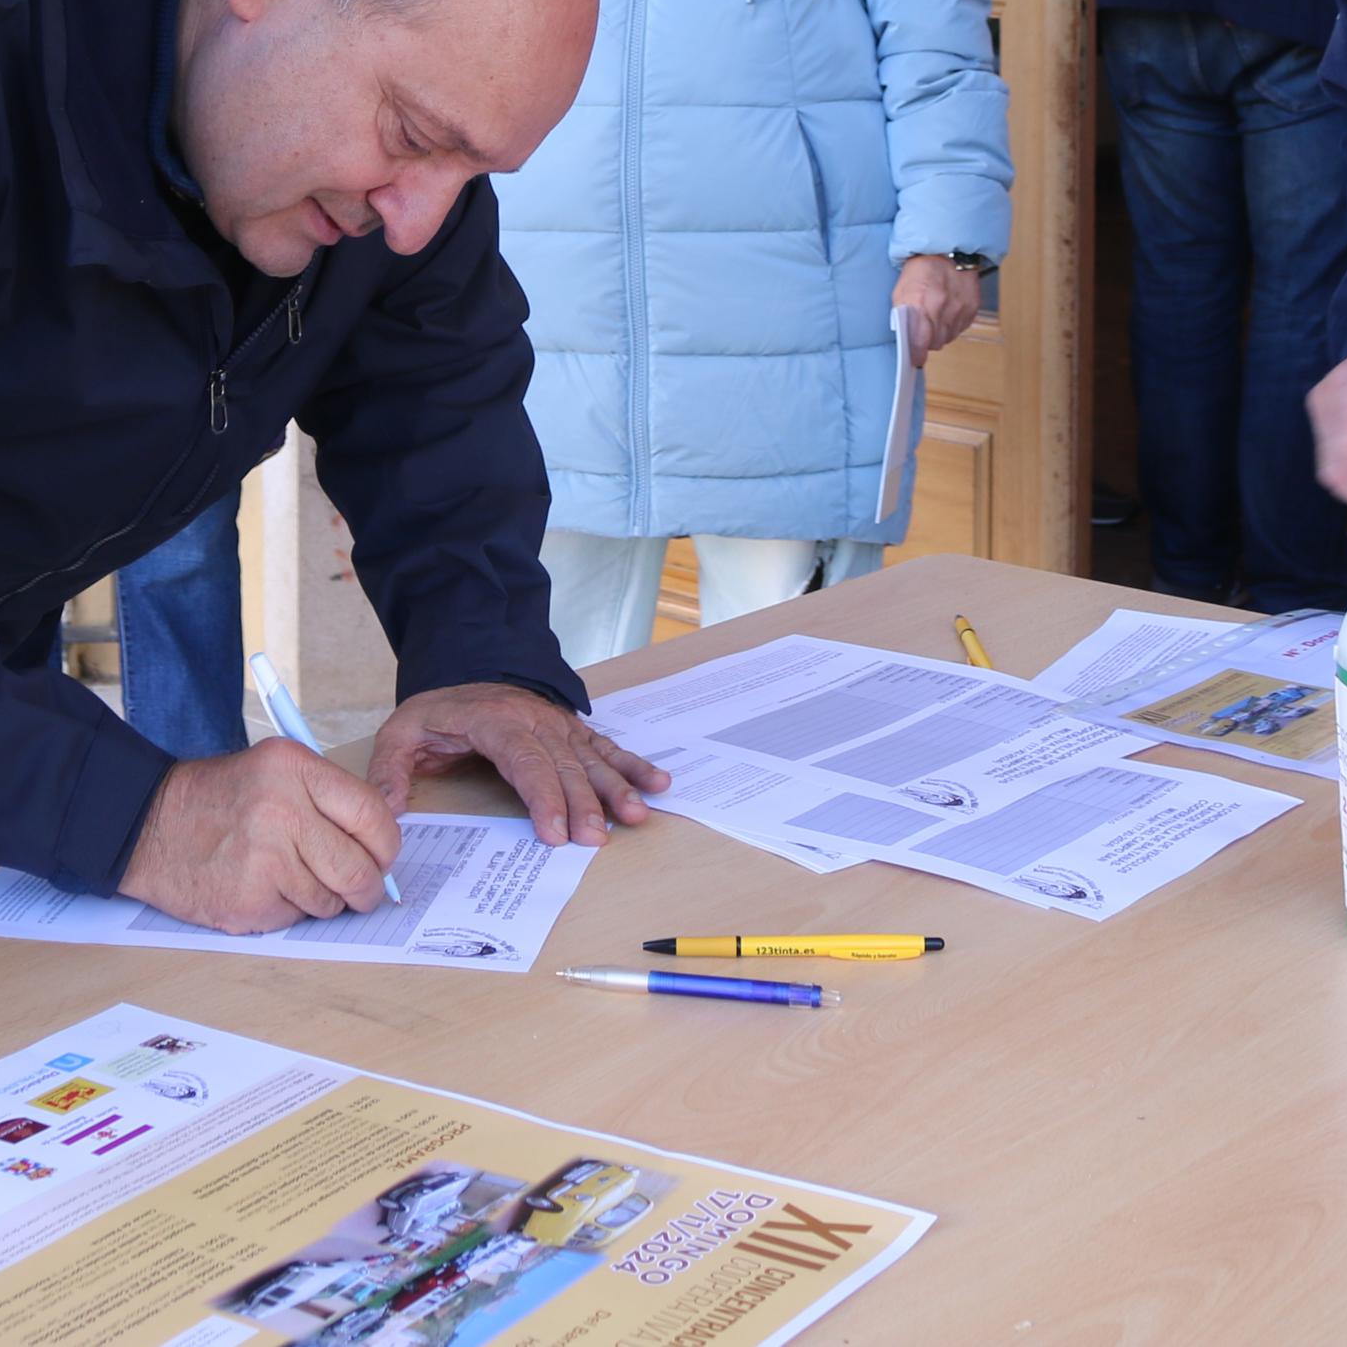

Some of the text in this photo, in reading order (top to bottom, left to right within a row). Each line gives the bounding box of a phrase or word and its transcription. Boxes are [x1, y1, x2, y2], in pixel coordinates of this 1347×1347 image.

[756, 946, 815, 957] 123tinta.es
[392, 1122, 472, 1171] PROGRAMA:
[612, 1190, 742, 1272] 17/11/2024
[639, 1190, 775, 1286] DOMINGO
[735, 1203, 872, 1272] XII
[629, 1256, 761, 1343] COOPERATIVA
